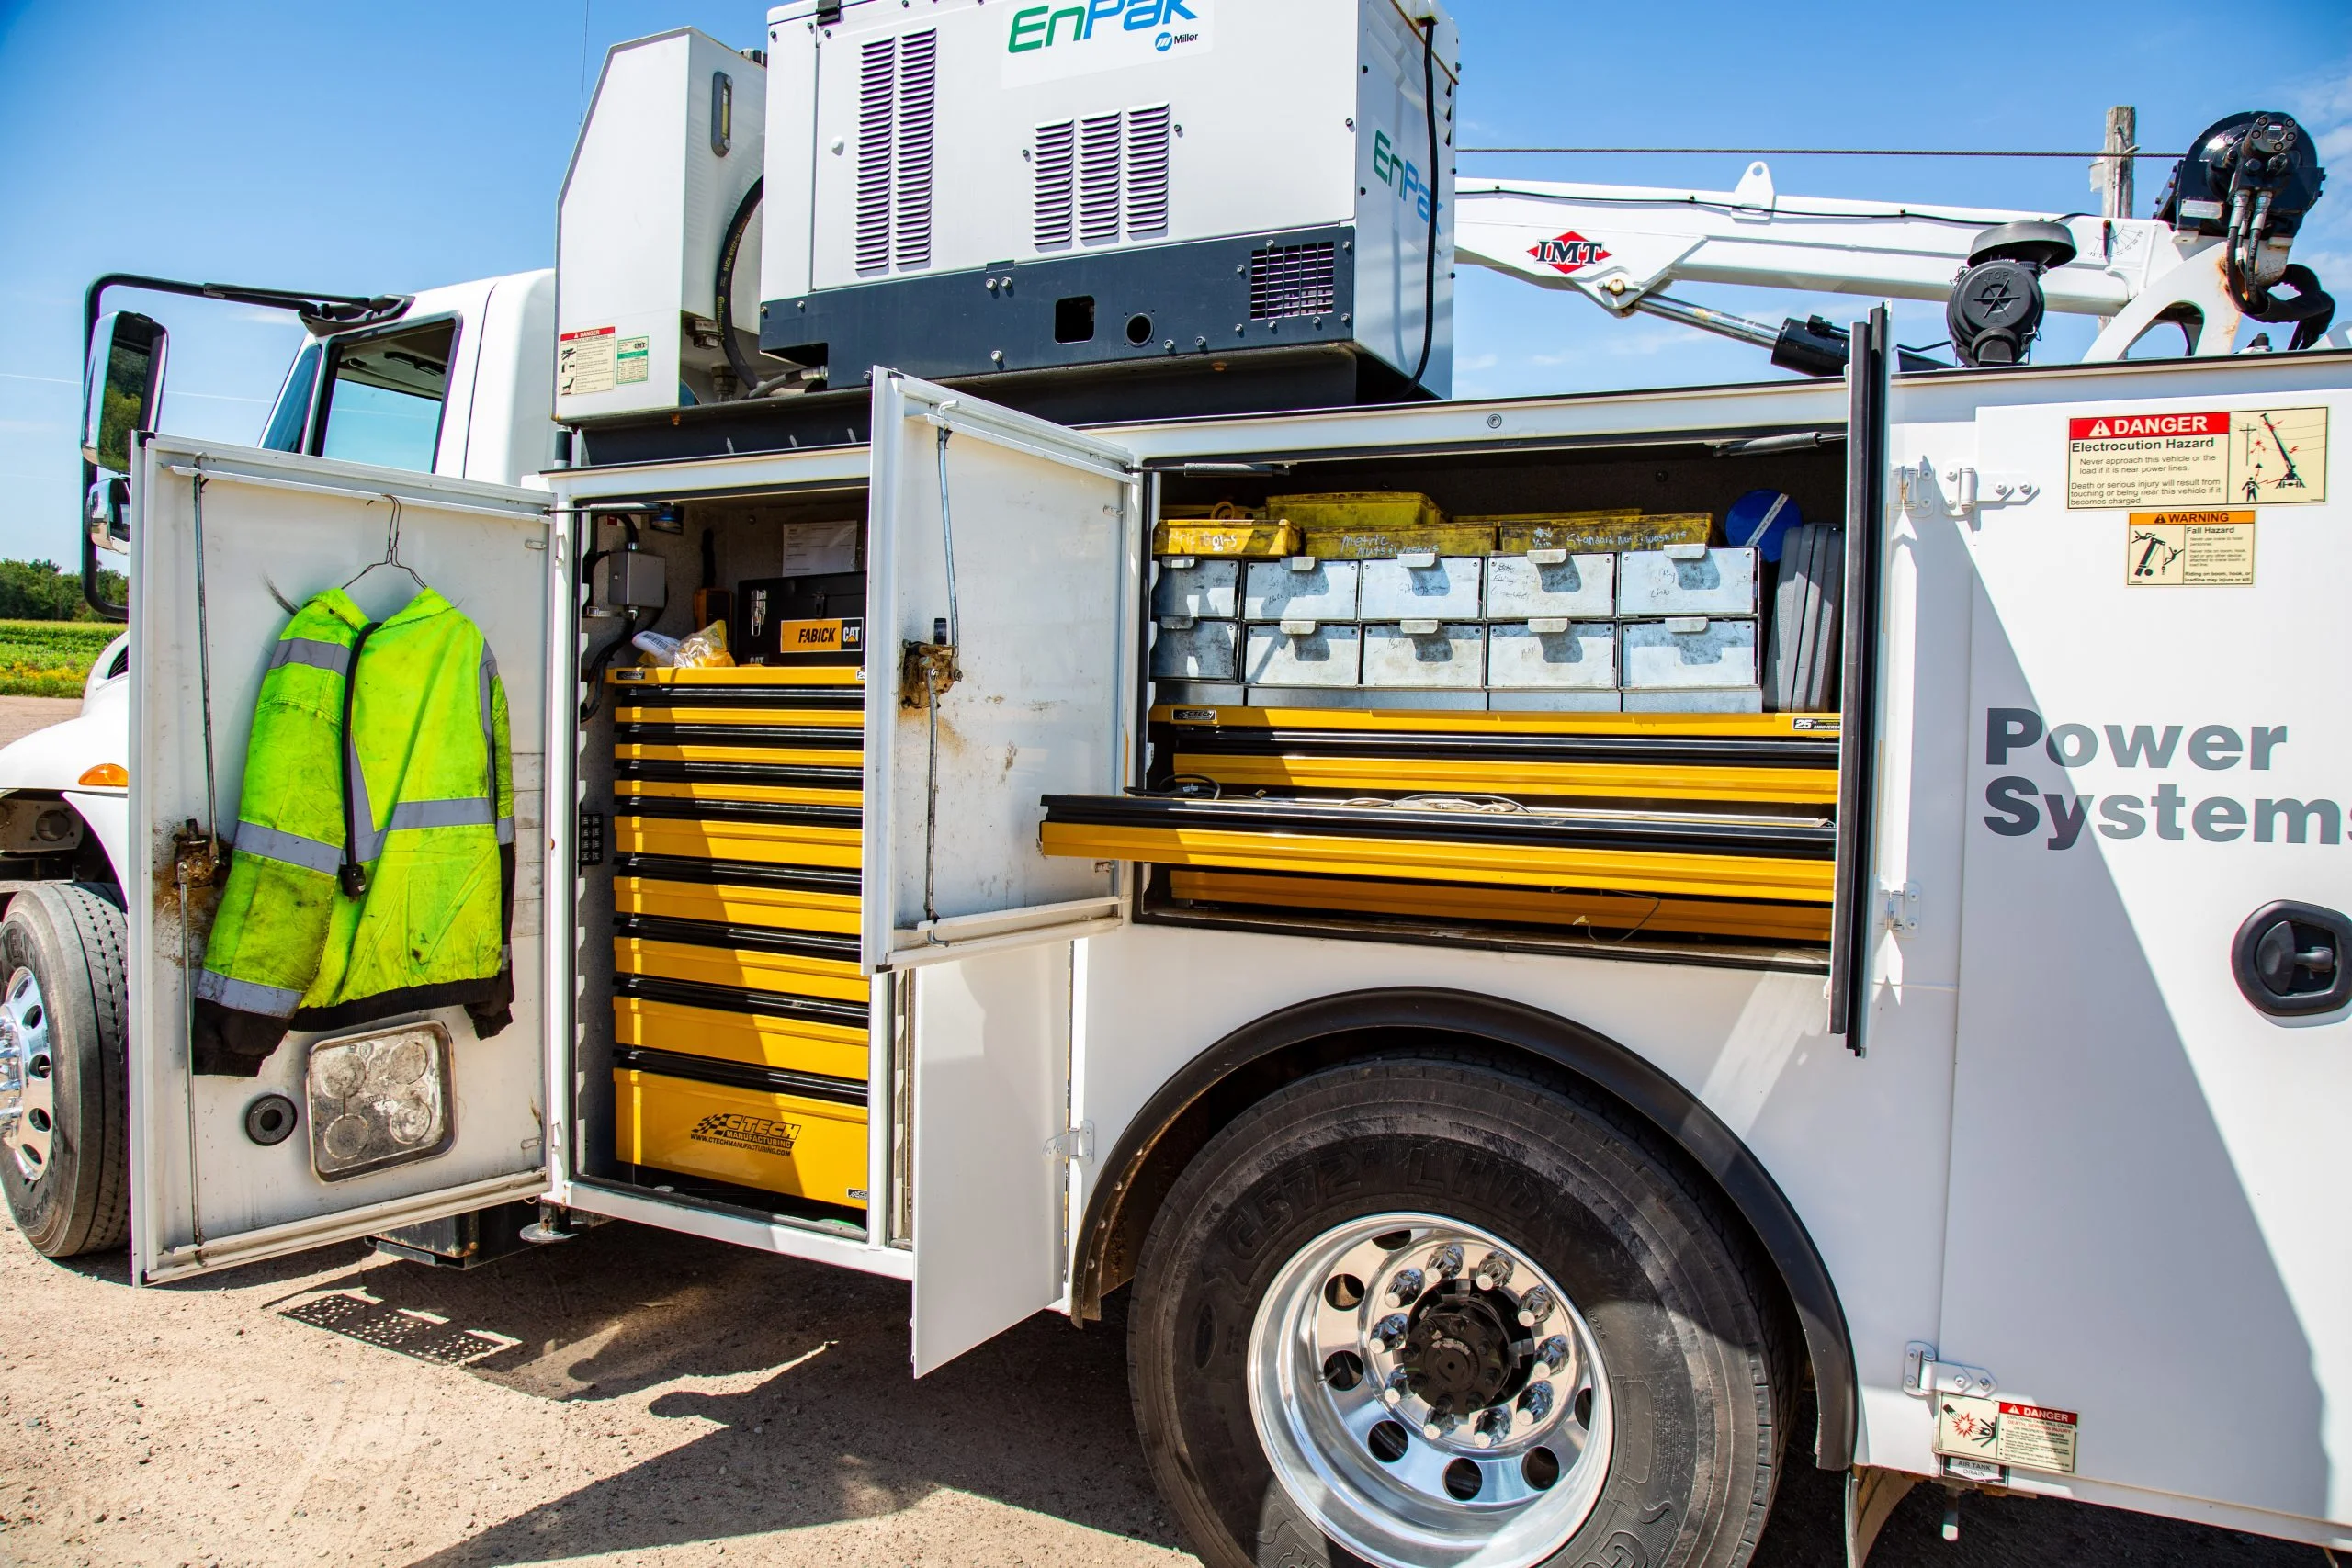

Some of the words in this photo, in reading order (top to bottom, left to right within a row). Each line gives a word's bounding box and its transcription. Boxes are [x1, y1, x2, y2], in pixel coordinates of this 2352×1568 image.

[1174, 32, 1198, 44] Miller
[1535, 241, 1603, 265] IMT
[1984, 270, 2010, 281] TOP
[2114, 415, 2208, 435] DANGER
[2072, 440, 2162, 452] Electrocution
[2166, 437, 2214, 448] Hazard
[2106, 457, 2143, 466] approach
[2142, 465, 2165, 473] power
[2138, 480, 2159, 489] injury
[2169, 513, 2230, 523] WARNING
[797, 627, 837, 644] FABICK
[842, 626, 861, 643] CAT
[1794, 719, 1813, 729] 25
[1985, 707, 2288, 771] Power
[1984, 775, 2352, 851] System
[725, 1114, 802, 1140] CTECH
[690, 1134, 791, 1157] WWW.CTECHMANUFACTURING.COM
[726, 1130, 793, 1149] MANUFACTURING
[2024, 1407, 2069, 1422] DANGER
[1963, 1469, 1985, 1478] DRAIN
[1973, 1462, 1991, 1471] TANK
